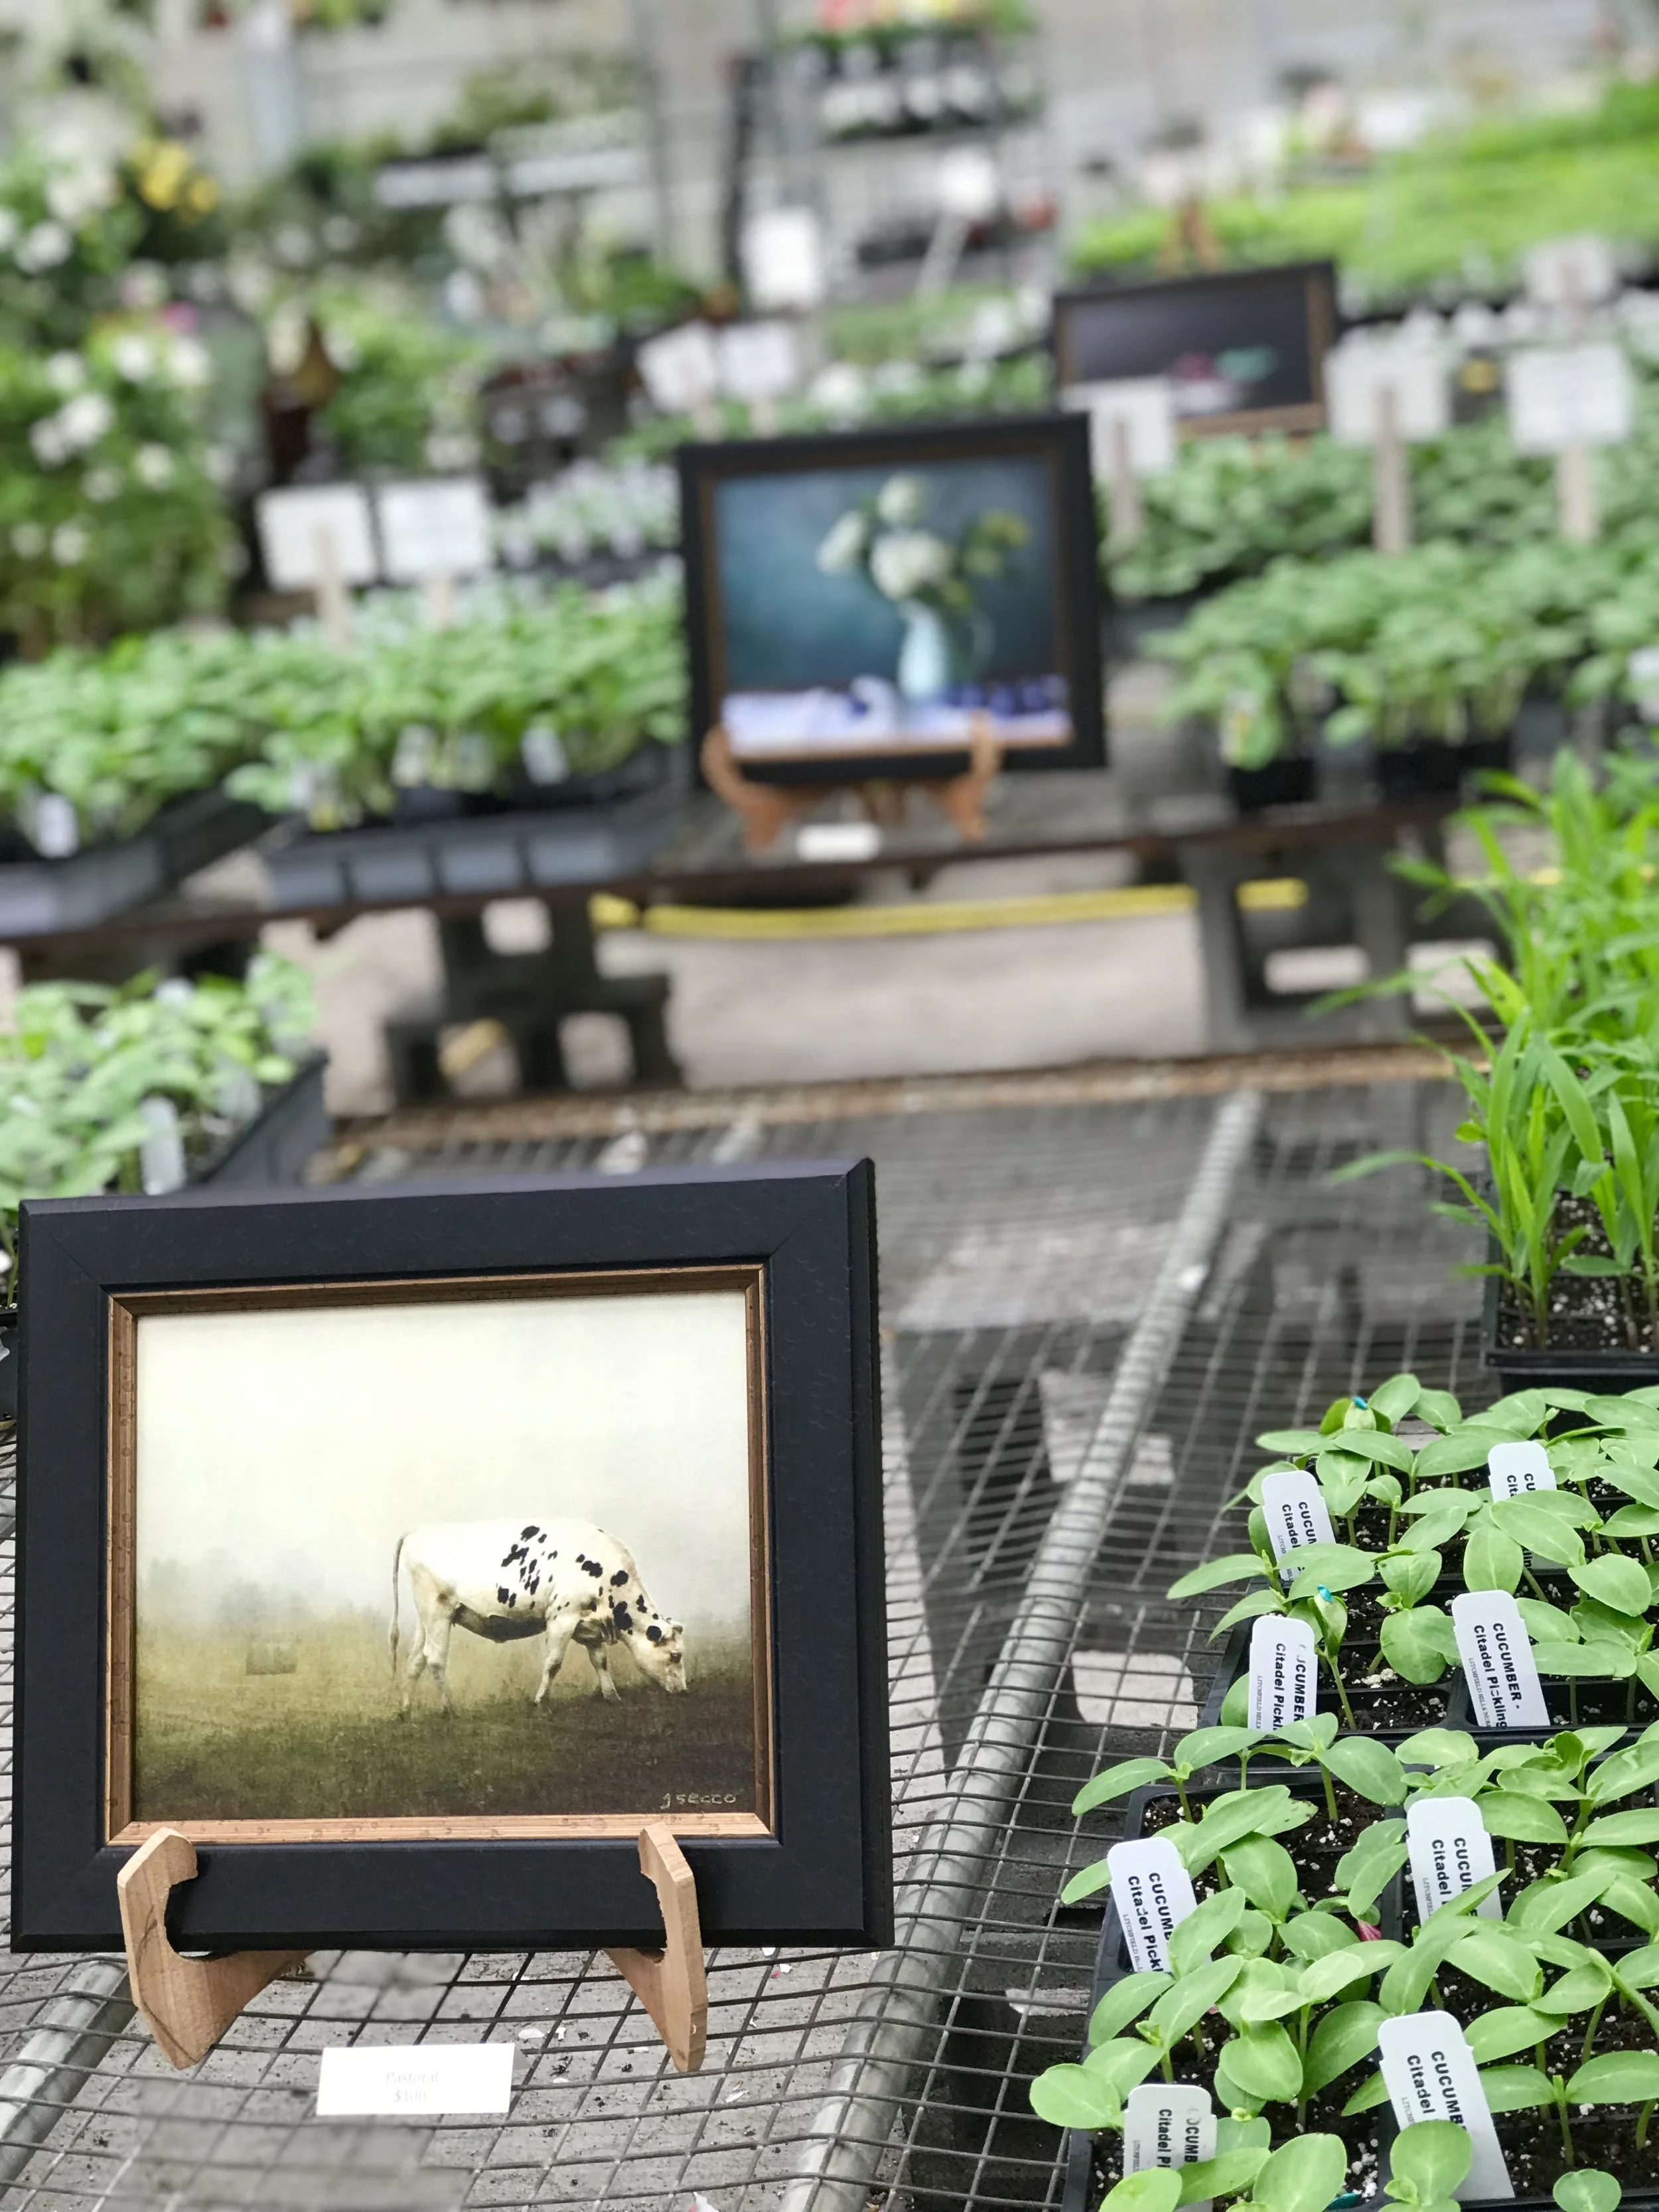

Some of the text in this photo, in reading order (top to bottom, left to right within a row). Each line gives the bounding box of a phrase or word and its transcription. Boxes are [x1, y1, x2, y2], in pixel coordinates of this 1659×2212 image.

[1282, 1504, 1301, 1548] Citadel
[1273, 1643, 1286, 1731] Citadel Pickl
[1474, 1625, 1507, 1728] Citadel Pickling
[1493, 1623, 1522, 1701] CUCUMBER
[1432, 1839, 1451, 1895] Citadel
[1128, 1876, 1152, 1930] Citadel
[386, 2070, 439, 2083] Pastoral
[394, 2089, 427, 2102] $100
[1407, 2055, 1435, 2114] Citadel
[1431, 2051, 1467, 2131] CUCUMB
[1157, 2109, 1172, 2152] Citadel
